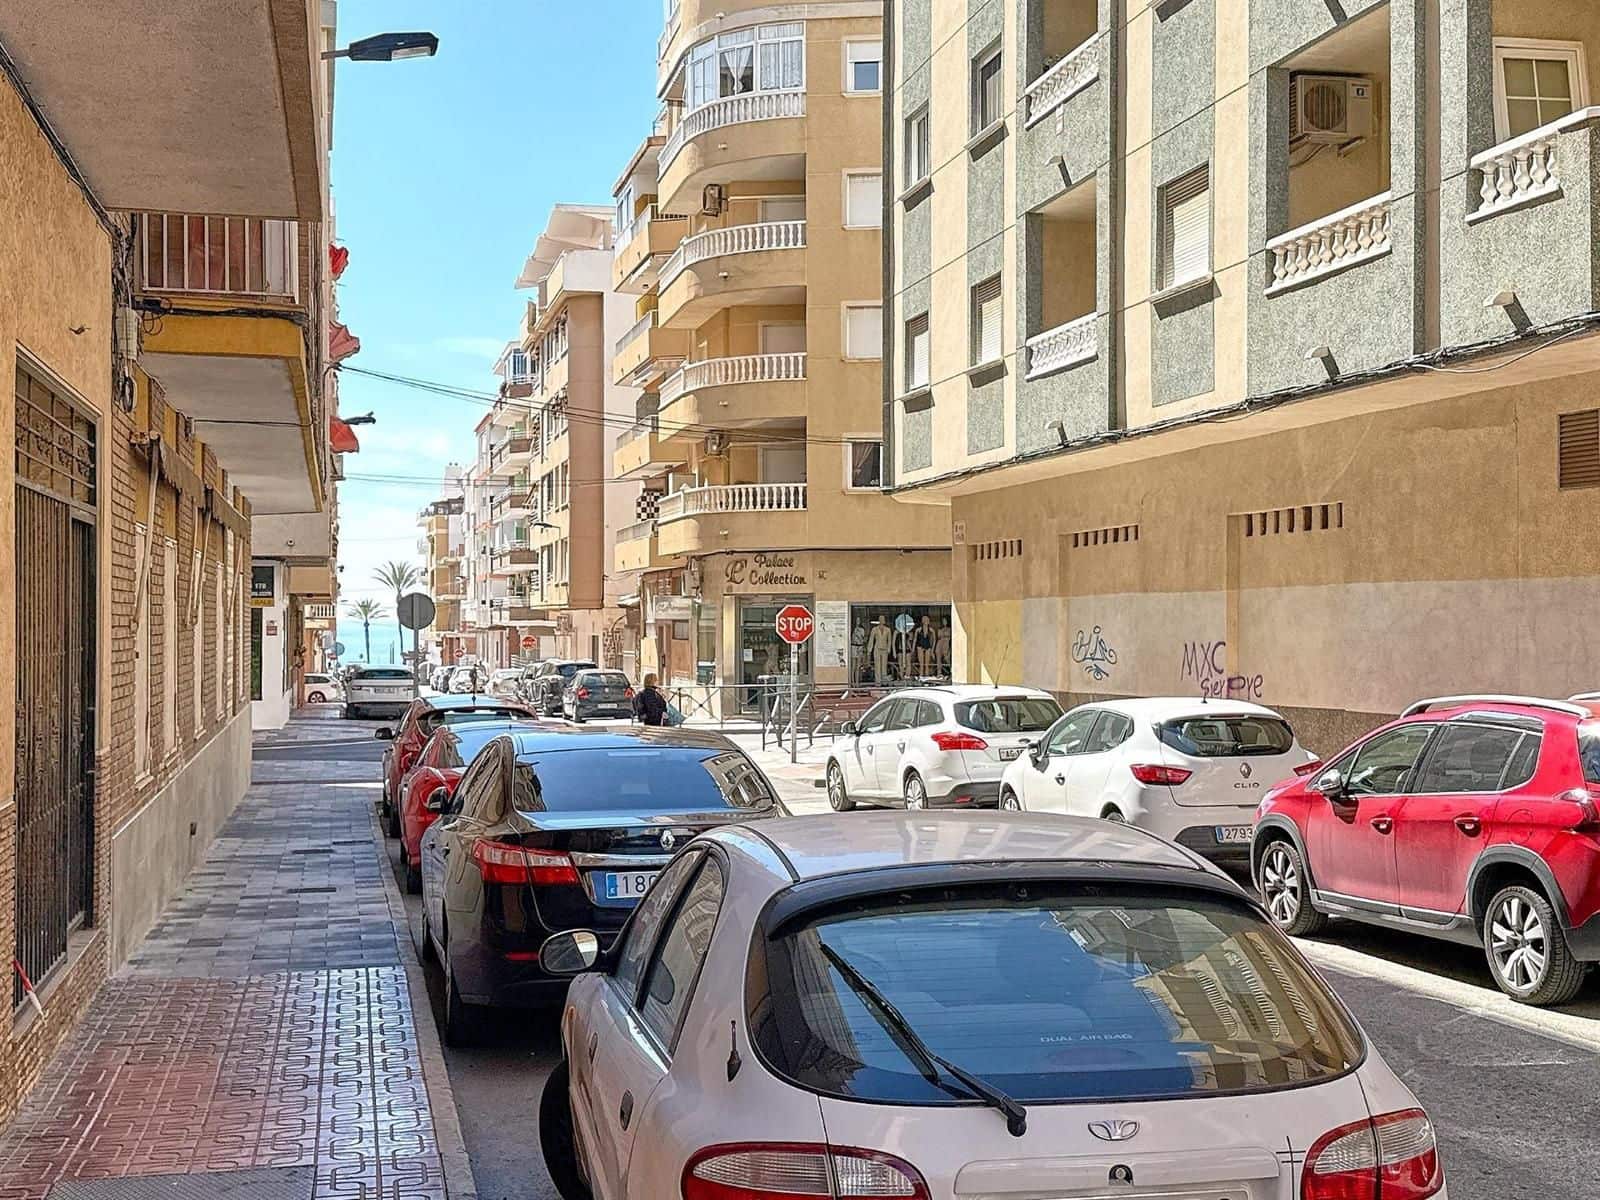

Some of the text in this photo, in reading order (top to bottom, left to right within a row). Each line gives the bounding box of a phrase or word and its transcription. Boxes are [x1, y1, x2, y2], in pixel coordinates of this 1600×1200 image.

[753, 553, 794, 568] Palace
[749, 569, 807, 585] Collection
[779, 616, 812, 632] STOP
[1180, 640, 1226, 682] MXC
[1224, 827, 1253, 840] 2793
